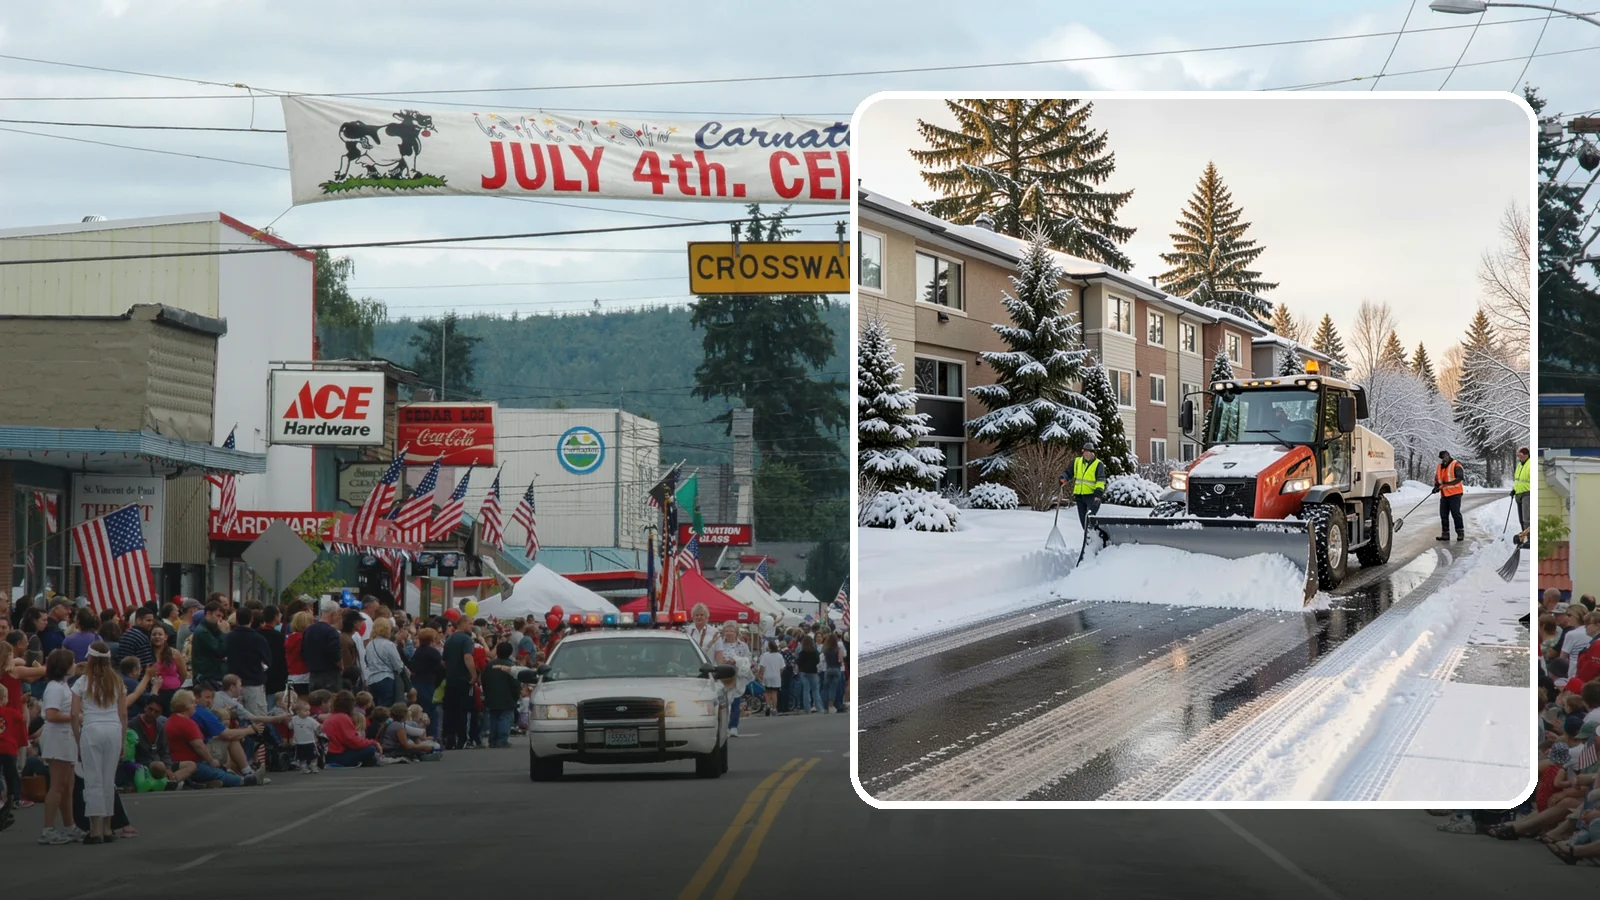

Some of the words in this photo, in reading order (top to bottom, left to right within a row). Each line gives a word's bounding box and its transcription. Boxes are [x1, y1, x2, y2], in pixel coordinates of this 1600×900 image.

[694, 121, 850, 150] Carnat
[481, 140, 604, 193] JULY
[632, 149, 746, 198] 4th.
[697, 254, 850, 280] CROSSWA
[283, 380, 373, 420] ACE
[405, 409, 452, 421] CEDAR
[461, 409, 485, 421] LOG
[284, 421, 371, 436] Hardware
[416, 427, 477, 447] Coca-Cola
[95, 485, 124, 494] Vincent
[126, 486, 136, 494] de
[137, 486, 155, 495] Paul
[699, 535, 730, 543] GLASS
